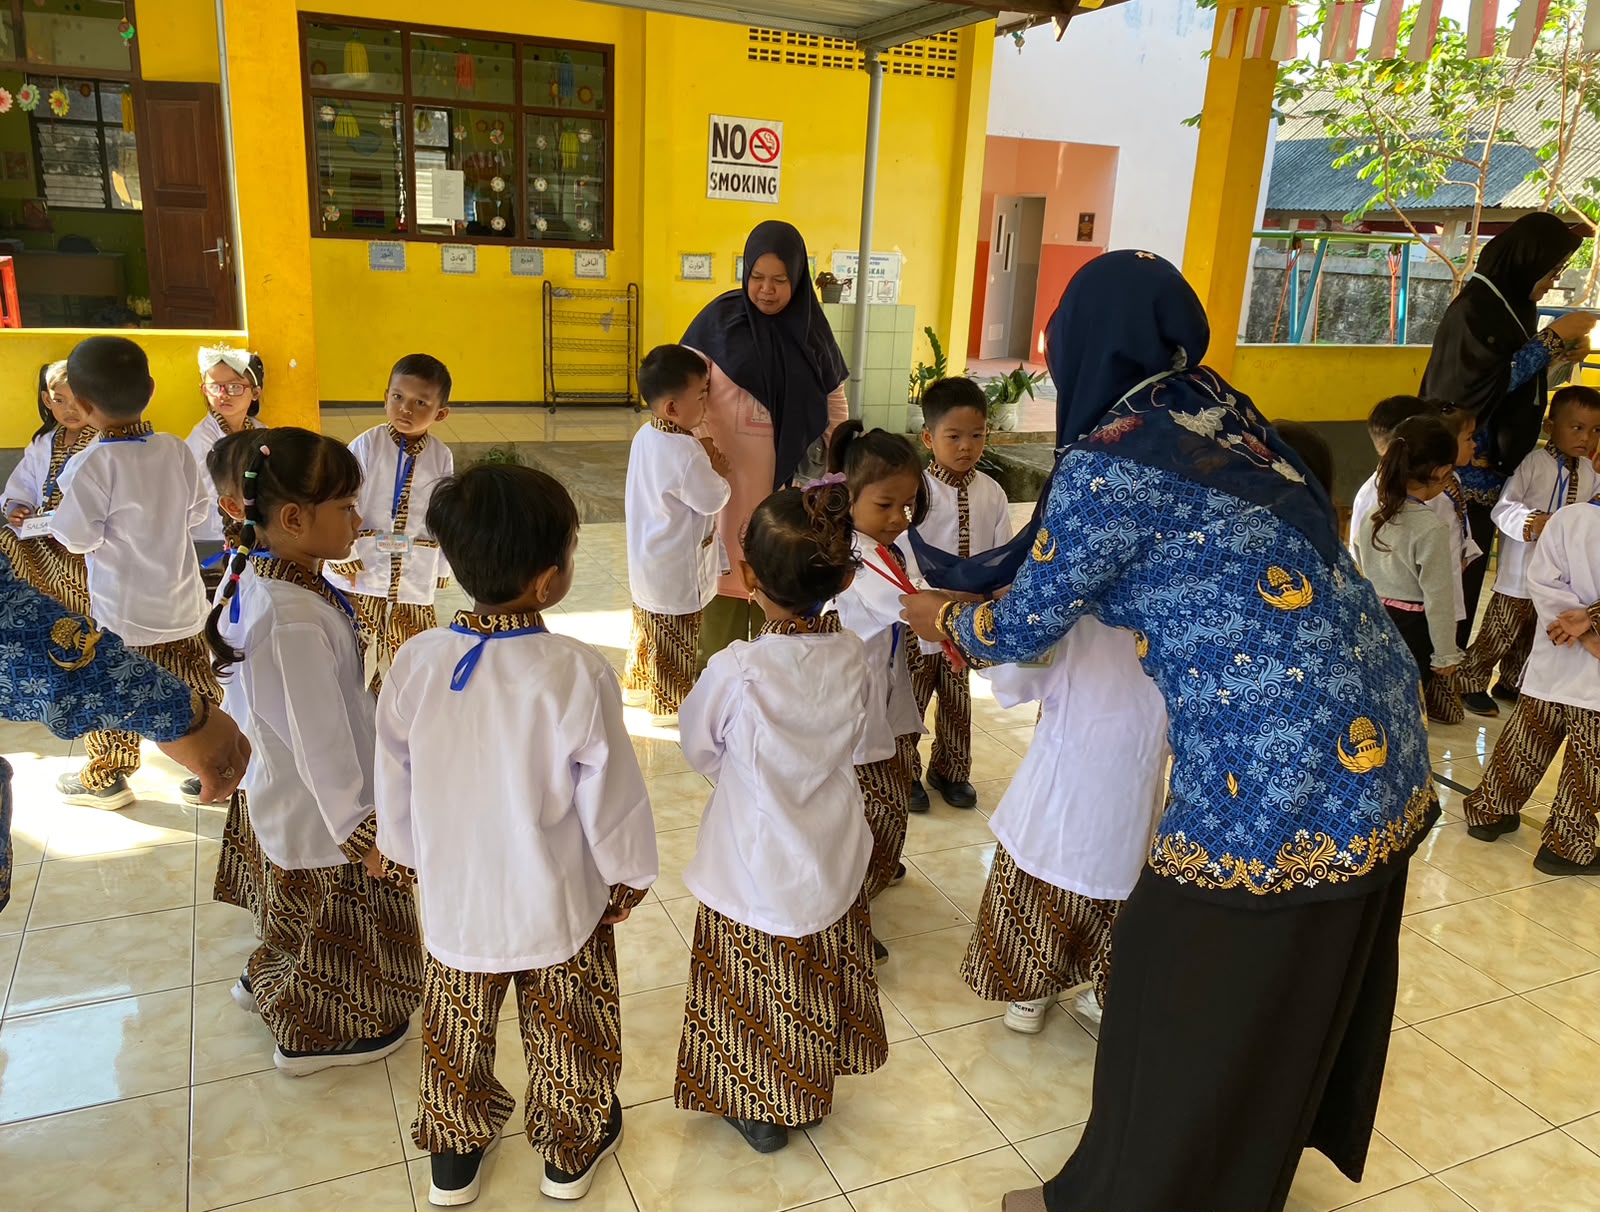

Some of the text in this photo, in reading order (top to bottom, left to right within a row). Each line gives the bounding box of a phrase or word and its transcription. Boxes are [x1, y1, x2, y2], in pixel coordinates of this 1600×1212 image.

[712, 122, 747, 160] NO
[710, 172, 777, 195] SMOKING
[26, 522, 49, 531] SALSA
